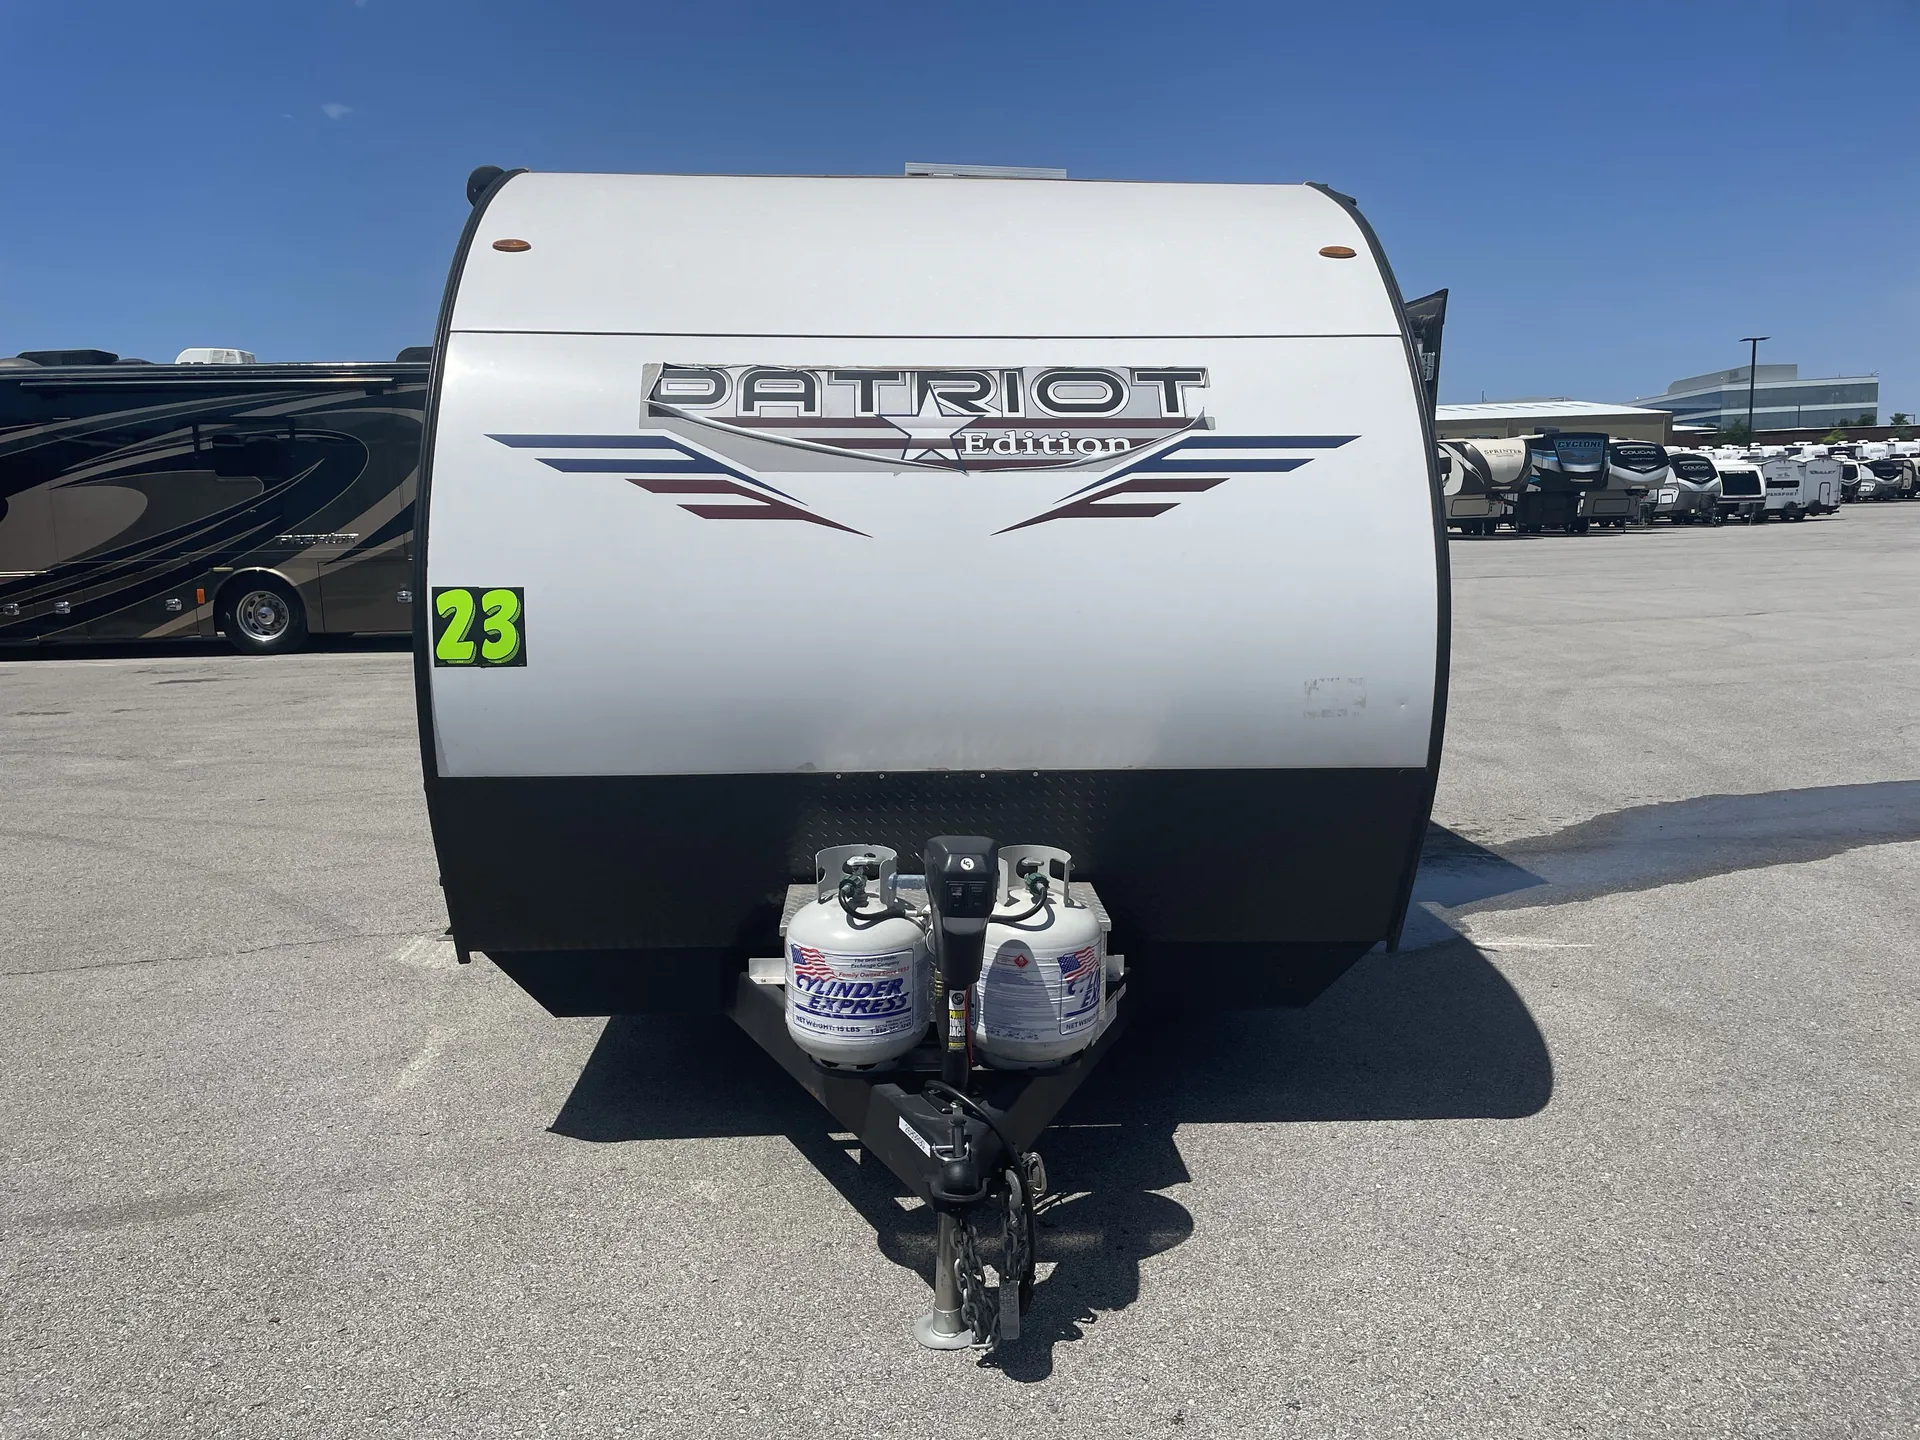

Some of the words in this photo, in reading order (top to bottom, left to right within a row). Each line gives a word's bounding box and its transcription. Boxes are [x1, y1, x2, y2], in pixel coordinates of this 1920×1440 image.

[649, 366, 1206, 418] PATRIOT
[960, 430, 1131, 456] Edition
[1557, 440, 1603, 448] CYCLONE
[436, 588, 522, 664] 23
[796, 974, 904, 999] CYLINDER
[808, 991, 910, 1014] EXPRESS
[796, 1015, 806, 1024] NET
[807, 1020, 835, 1032] WEIGHT:
[1065, 1021, 1078, 1030] NET
